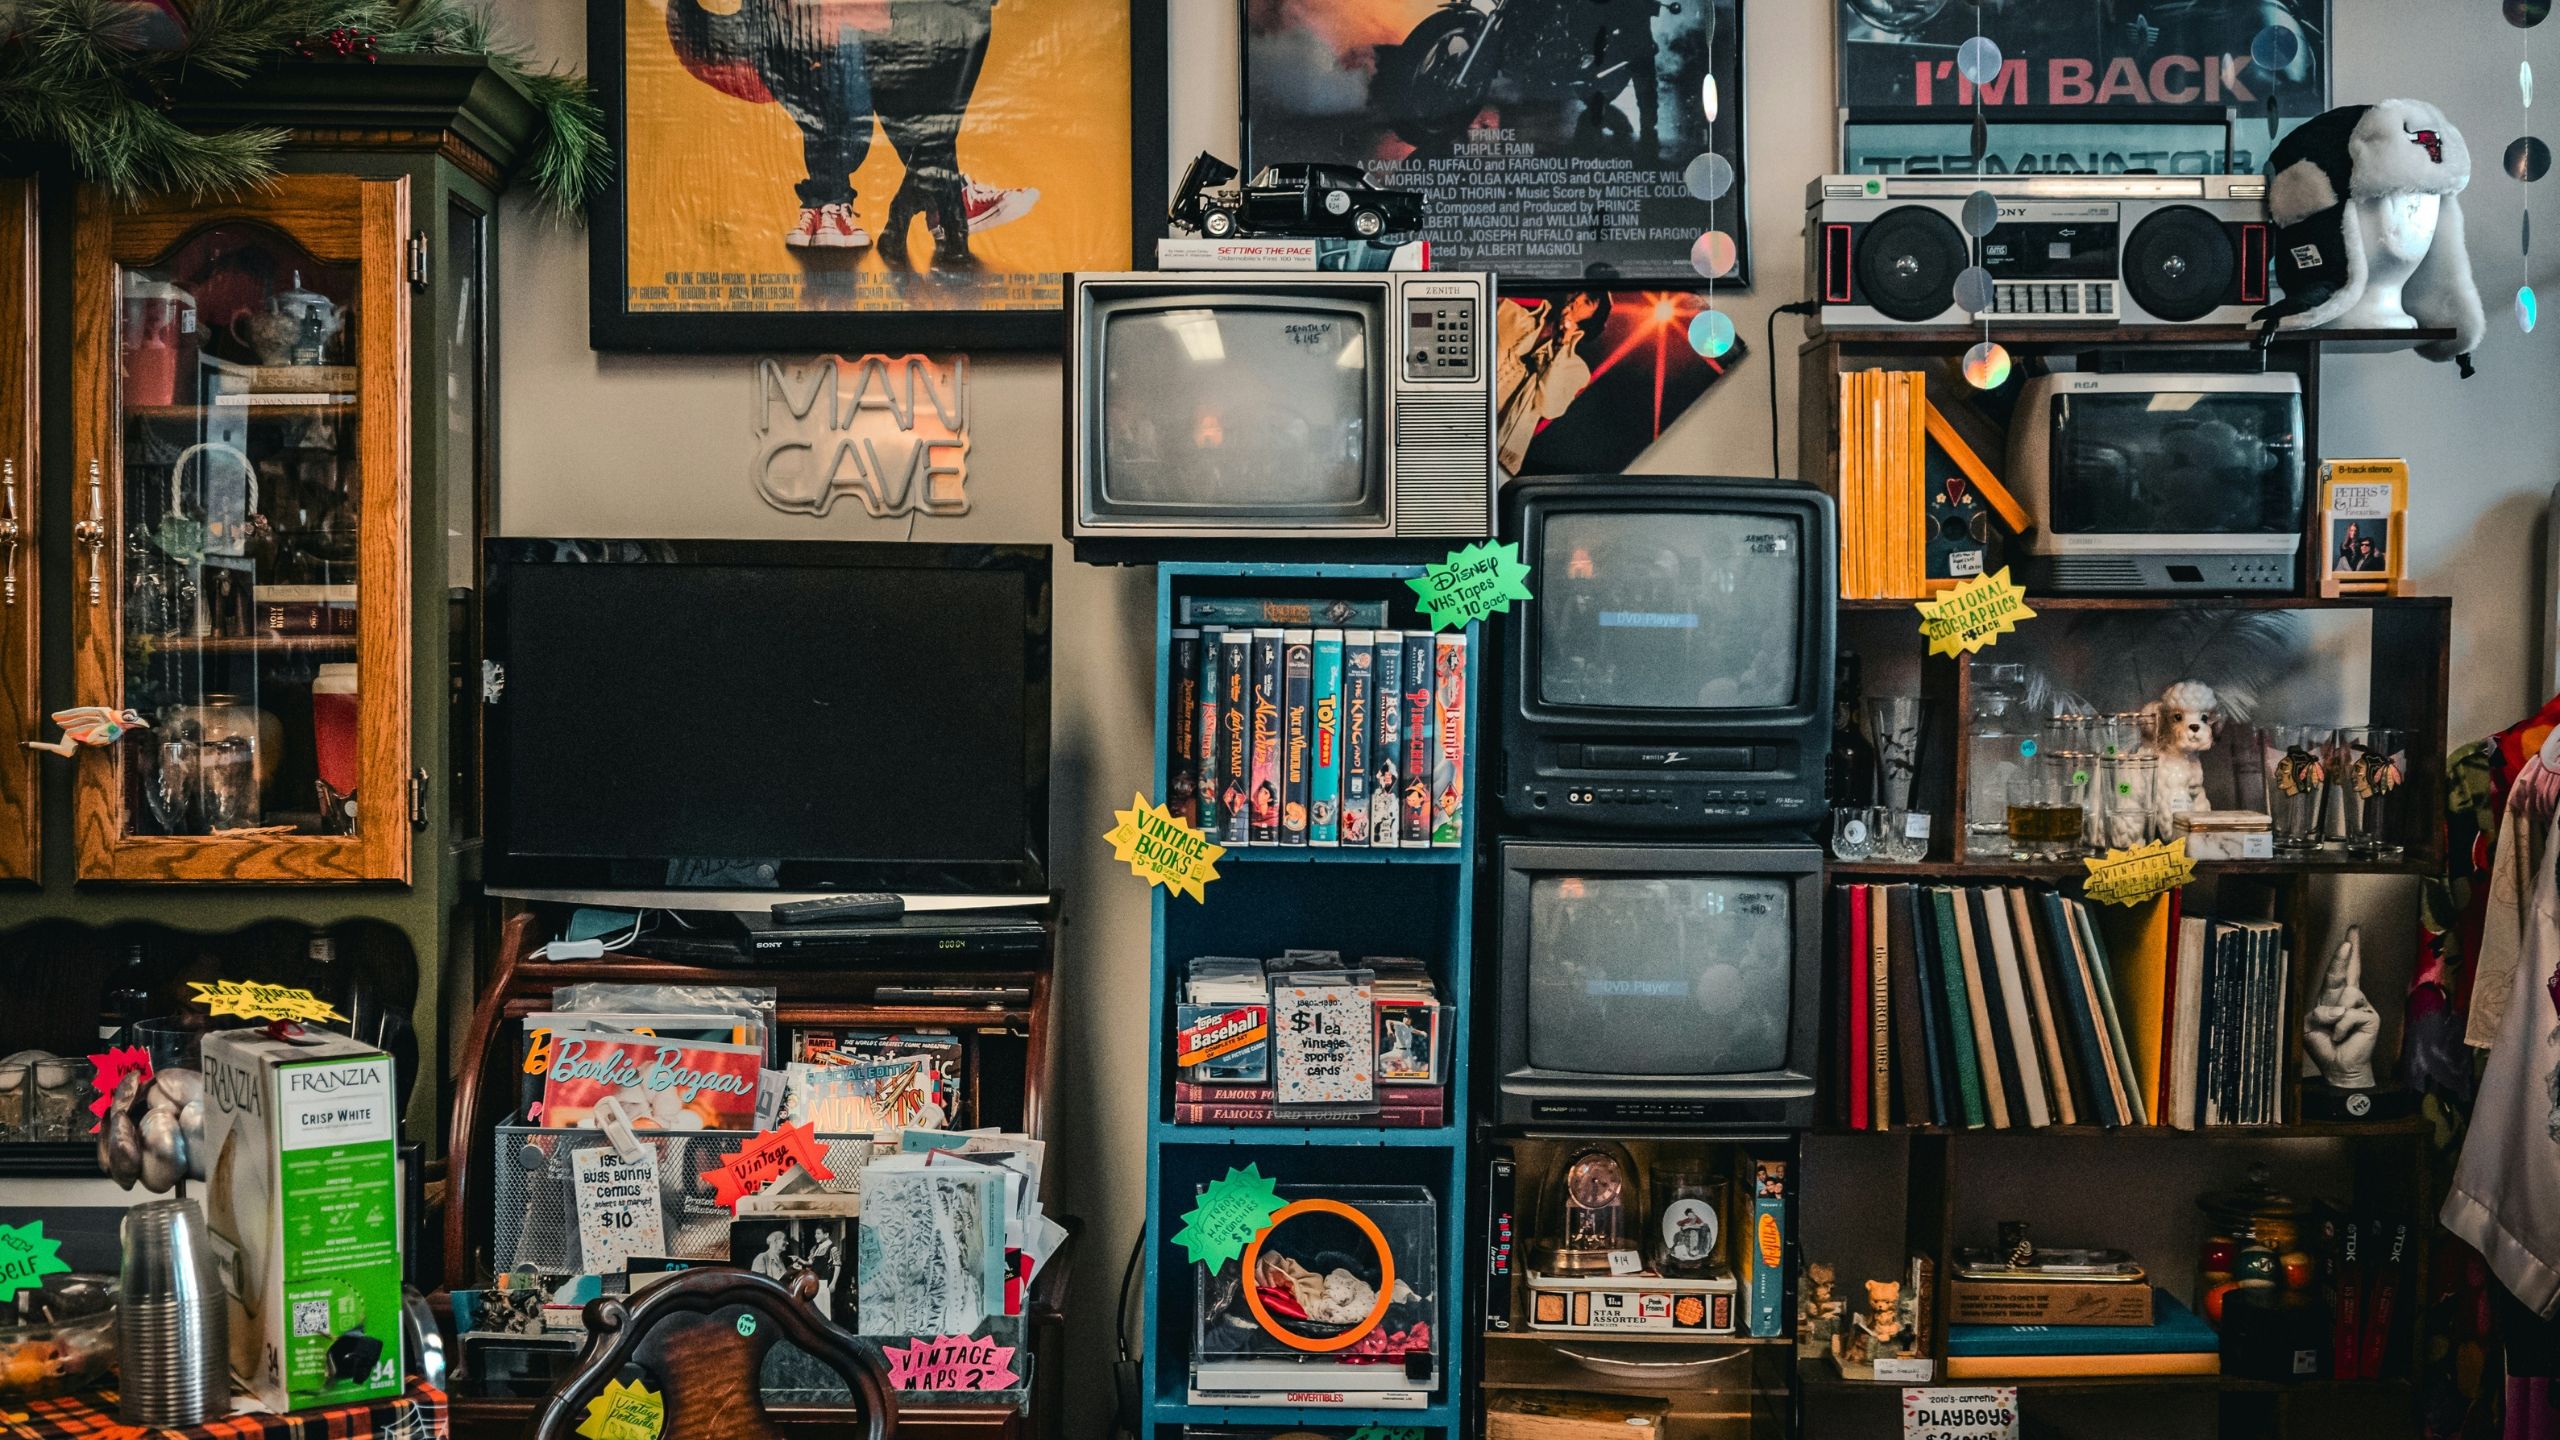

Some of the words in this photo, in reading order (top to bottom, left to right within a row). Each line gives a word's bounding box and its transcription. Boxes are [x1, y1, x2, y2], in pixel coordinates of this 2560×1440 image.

[1915, 59, 2028, 105] I'M
[2048, 55, 2261, 105] BACK
[1471, 128, 1516, 141] PRINCE
[1454, 143, 1500, 156] PURPLE
[1505, 143, 1534, 156] RAIN
[1368, 159, 1426, 173] CAVALLO,
[1428, 158, 1482, 171] RUFFALO
[1485, 158, 1505, 171] and
[1509, 158, 1569, 171] FARGNOLI
[1571, 157, 1633, 170] Production
[1384, 174, 1434, 186] MORRIS
[1437, 173, 1461, 185] DAY
[1469, 173, 1501, 185] OLGA
[1505, 172, 1567, 184] KARLATOS
[1570, 172, 1591, 184] and
[1593, 171, 1657, 184] CLARENCE
[1460, 187, 1506, 199] THORIN
[1516, 186, 1550, 199] Music
[1552, 186, 1585, 198] Score
[1588, 186, 1602, 200] by
[1605, 185, 1650, 198] MICHEL
[1435, 201, 1496, 216] Composed
[1499, 201, 1520, 213] and
[1523, 201, 1576, 213] Produced
[1580, 201, 1593, 214] by
[1596, 200, 1641, 212] PRINCE
[1463, 215, 1519, 228] MAGNOLI
[1522, 215, 1543, 228] and
[1546, 215, 1600, 227] WILLIAM
[1602, 214, 1640, 226] BLINN
[1470, 229, 1516, 242] JOSEPH
[1519, 229, 1573, 241] RUFFALO
[1576, 229, 1597, 241] and
[1600, 228, 1646, 240] STEVEN
[1218, 247, 1263, 255] SETTING
[1265, 247, 1285, 255] THE
[1286, 247, 1312, 255] PACE
[1459, 243, 1474, 258] by
[1476, 243, 1523, 256] ALBERT
[1526, 243, 1583, 255] MAGNOLI
[1426, 286, 1460, 295] ZENITH
[759, 357, 964, 432] MAN
[2073, 381, 2099, 389] RCA
[759, 438, 964, 508] CAVE
[2338, 465, 2367, 474] 8-track
[2368, 465, 2394, 474] stereo
[2335, 487, 2378, 498] PETERS
[2348, 498, 2369, 508] LEE
[1427, 594, 1456, 613] VHS
[1453, 578, 1495, 602] Tapes
[1456, 600, 1481, 617] $10
[1482, 592, 1509, 610] each
[1926, 580, 2008, 619] NATIONAL
[269, 606, 277, 629] HOLY
[276, 607, 284, 629] BIBLE
[1616, 613, 1641, 624] DVD
[1646, 613, 1681, 626] Player
[1928, 594, 2018, 641] GEOGRAPHICS
[1976, 620, 2001, 636] EACH
[1254, 684, 1279, 764] Aladdin
[1317, 694, 1337, 735] TOY
[1351, 699, 1365, 745] KING
[1443, 707, 1461, 760] Bambi
[1231, 739, 1242, 778] TRAMP
[1321, 733, 1330, 764] STORY
[1137, 808, 1210, 860] VINTAGE
[1135, 833, 1192, 875] BOOKS
[2102, 858, 2170, 881] VINTAGE
[756, 941, 783, 949] SONY
[1603, 981, 1630, 993] DVD
[1634, 981, 1670, 995] Player
[1876, 976, 1888, 1033] MIRROR
[1190, 1010, 1258, 1051] Baseball
[808, 1039, 835, 1048] MARVEL
[878, 1040, 905, 1048] GREATEST
[1204, 1039, 1236, 1054] COMPLETE
[1236, 1033, 1248, 1043] SET
[1301, 1038, 1347, 1050] vintage
[1304, 1052, 1345, 1063] sports
[1876, 1043, 1889, 1074] 1964
[291, 1067, 381, 1093] FRANZIA
[550, 1037, 644, 1088] Barbie
[648, 1046, 754, 1103] Bazaar
[806, 1067, 864, 1084] SPECIAL
[1307, 1065, 1341, 1076] cards
[203, 1055, 262, 1117] FRANZIA
[1214, 1090, 1257, 1100] FAMOUS
[1213, 1109, 1264, 1120] FAMOUS
[734, 1145, 790, 1180] Vintage
[602, 1211, 634, 1229] $10
[2346, 1232, 2357, 1262] TDK
[2390, 1234, 2406, 1264] TDK
[902, 1346, 997, 1372] VINTAGE
[905, 1369, 958, 1390] MAPS
[1287, 1392, 1344, 1403] CONVERTIBLES
[609, 1407, 655, 1431] Postcards
[615, 1396, 661, 1421] Vintage
[1918, 1408, 2011, 1427] PLAYBOYS
